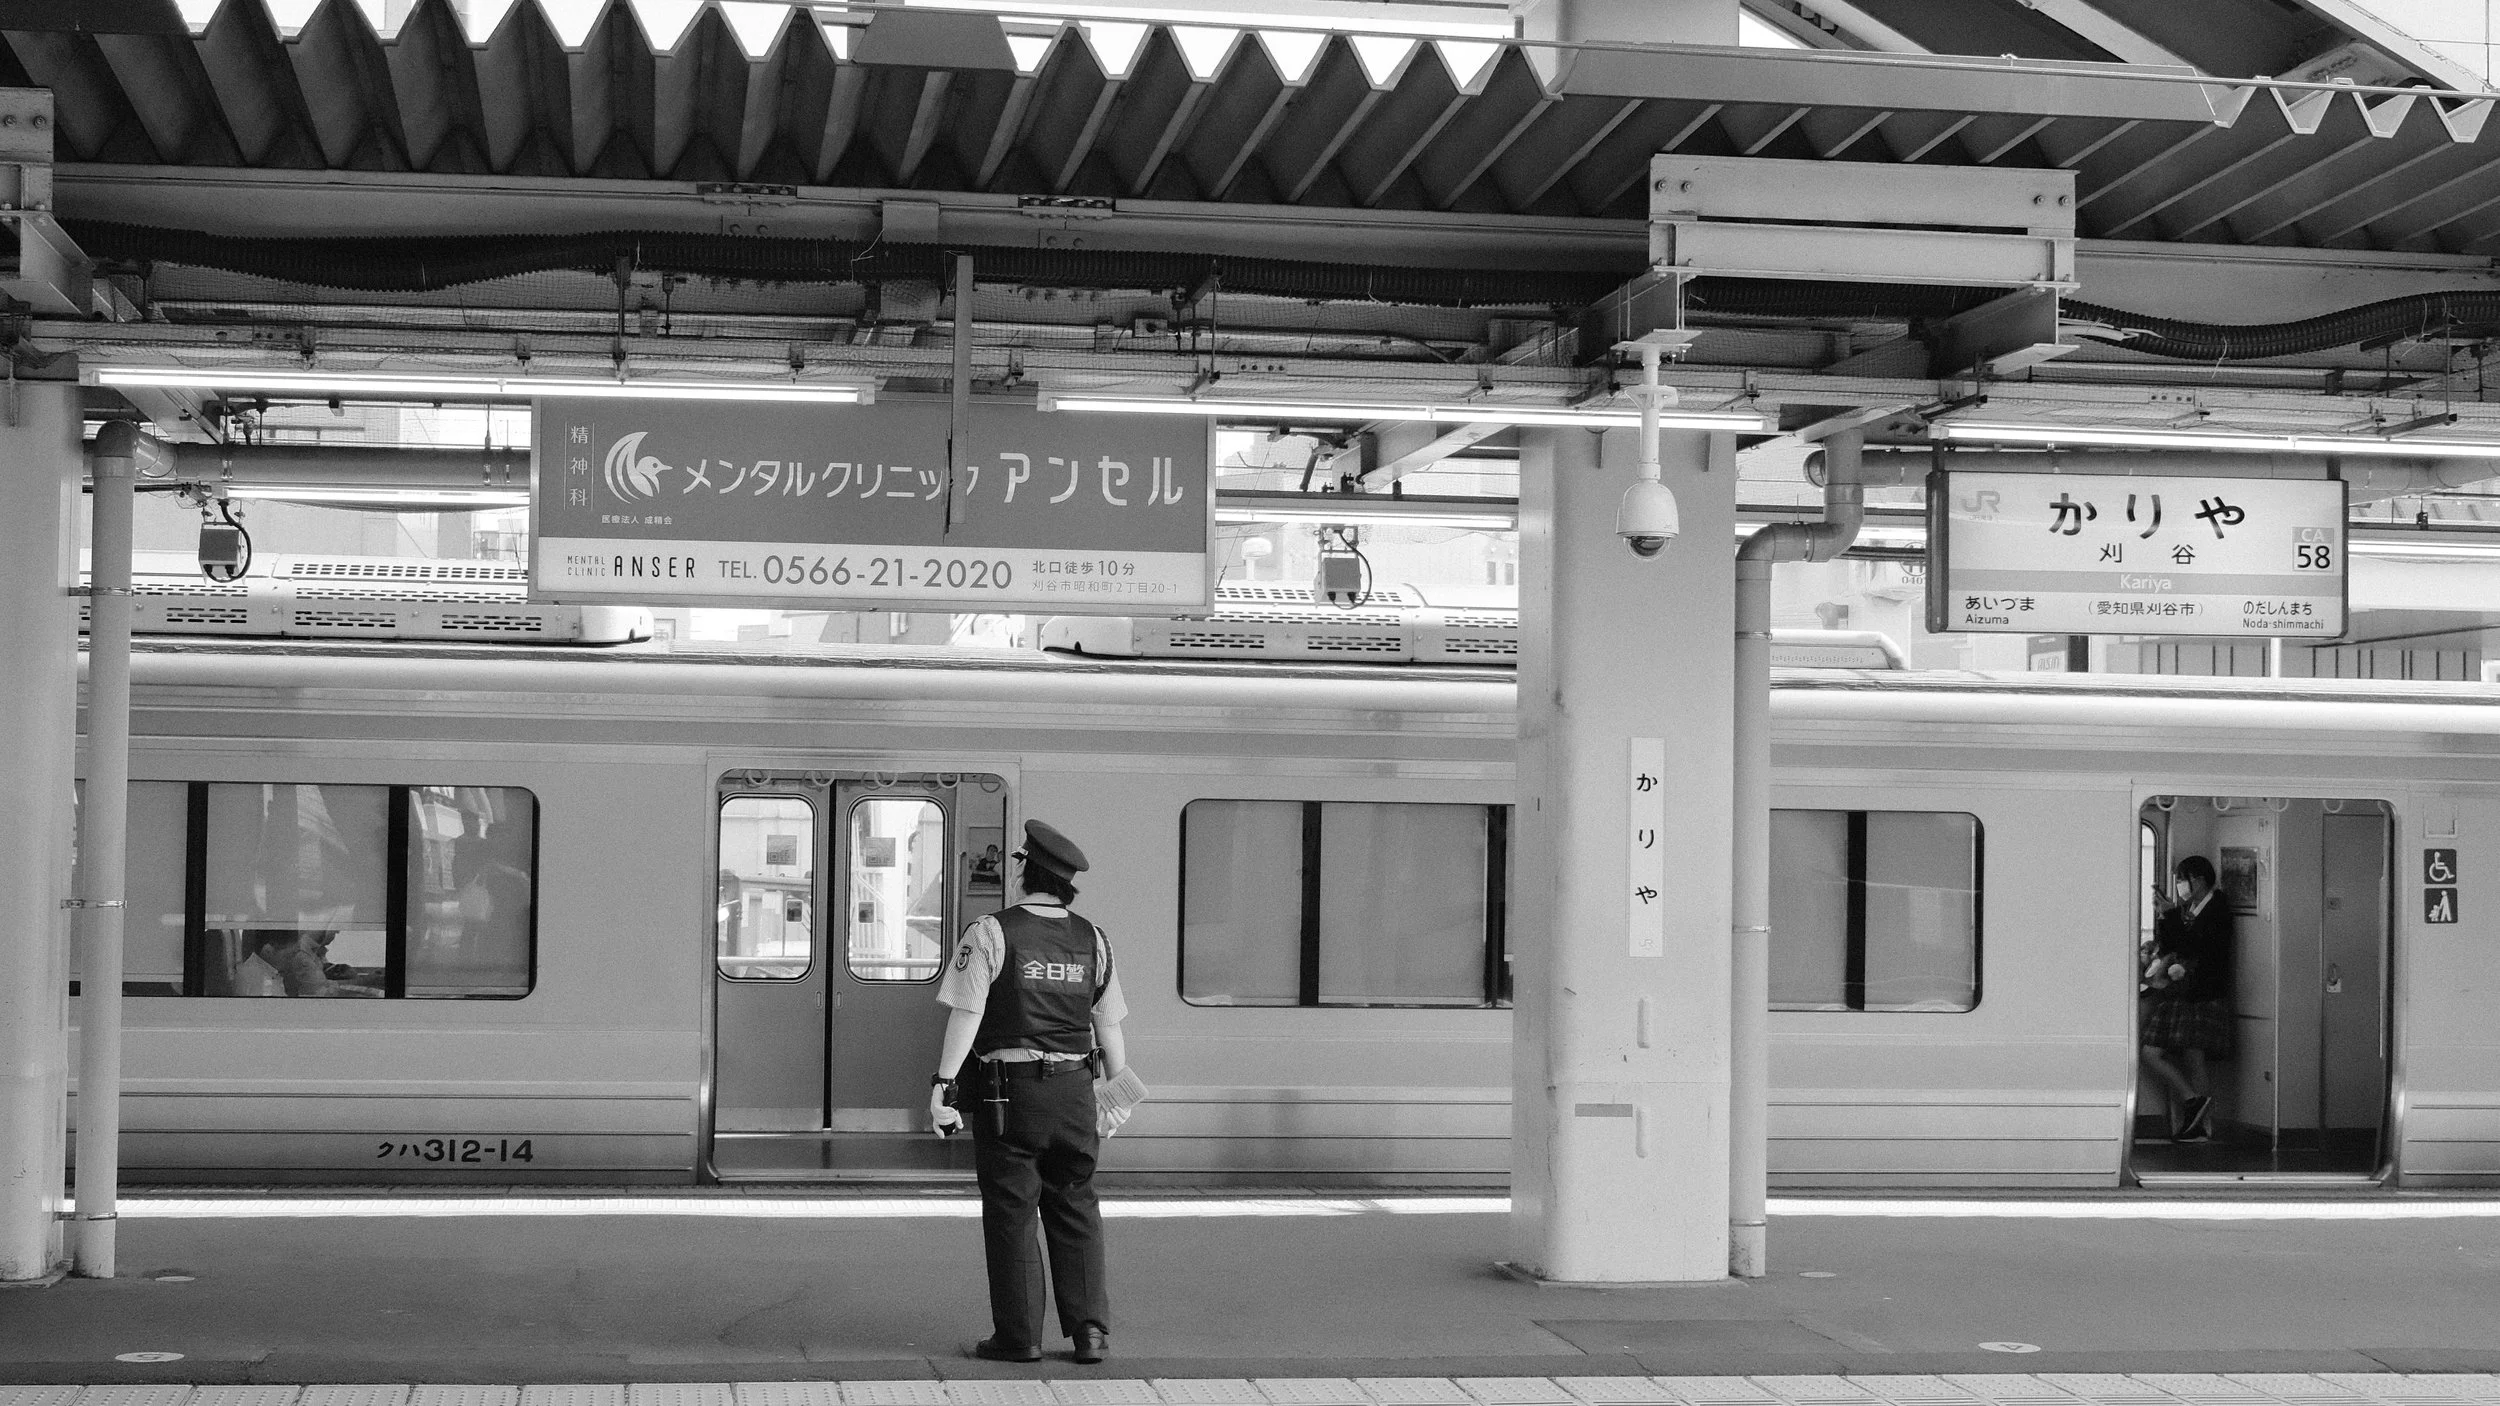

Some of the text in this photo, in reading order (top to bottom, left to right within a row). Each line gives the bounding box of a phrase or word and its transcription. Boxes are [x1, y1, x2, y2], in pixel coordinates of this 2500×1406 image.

[568, 424, 590, 507] 精神科
[999, 452, 1185, 506] アンセル
[1960, 490, 2001, 513] JR
[601, 514, 640, 524] 医療法人
[2049, 492, 2246, 540] かりや
[2301, 528, 2325, 542] CA
[567, 555, 606, 566] MENTAL
[2099, 543, 2197, 565] 刈谷
[2297, 545, 2331, 569] 58
[567, 566, 606, 577] CLINIC
[614, 555, 696, 578] ANSER
[718, 555, 1013, 590] TEL. 0566-21-2020
[2119, 574, 2173, 591] Kariya
[1964, 596, 2036, 611] あいづま
[2243, 600, 2314, 615] のだしんまち
[1964, 614, 2010, 625] Aizuma
[2242, 618, 2325, 629] Noda-shimmachi
[1634, 772, 1659, 905] かりや
[1022, 959, 1086, 983] 全日警
[377, 1138, 534, 1162] クハ312-14
